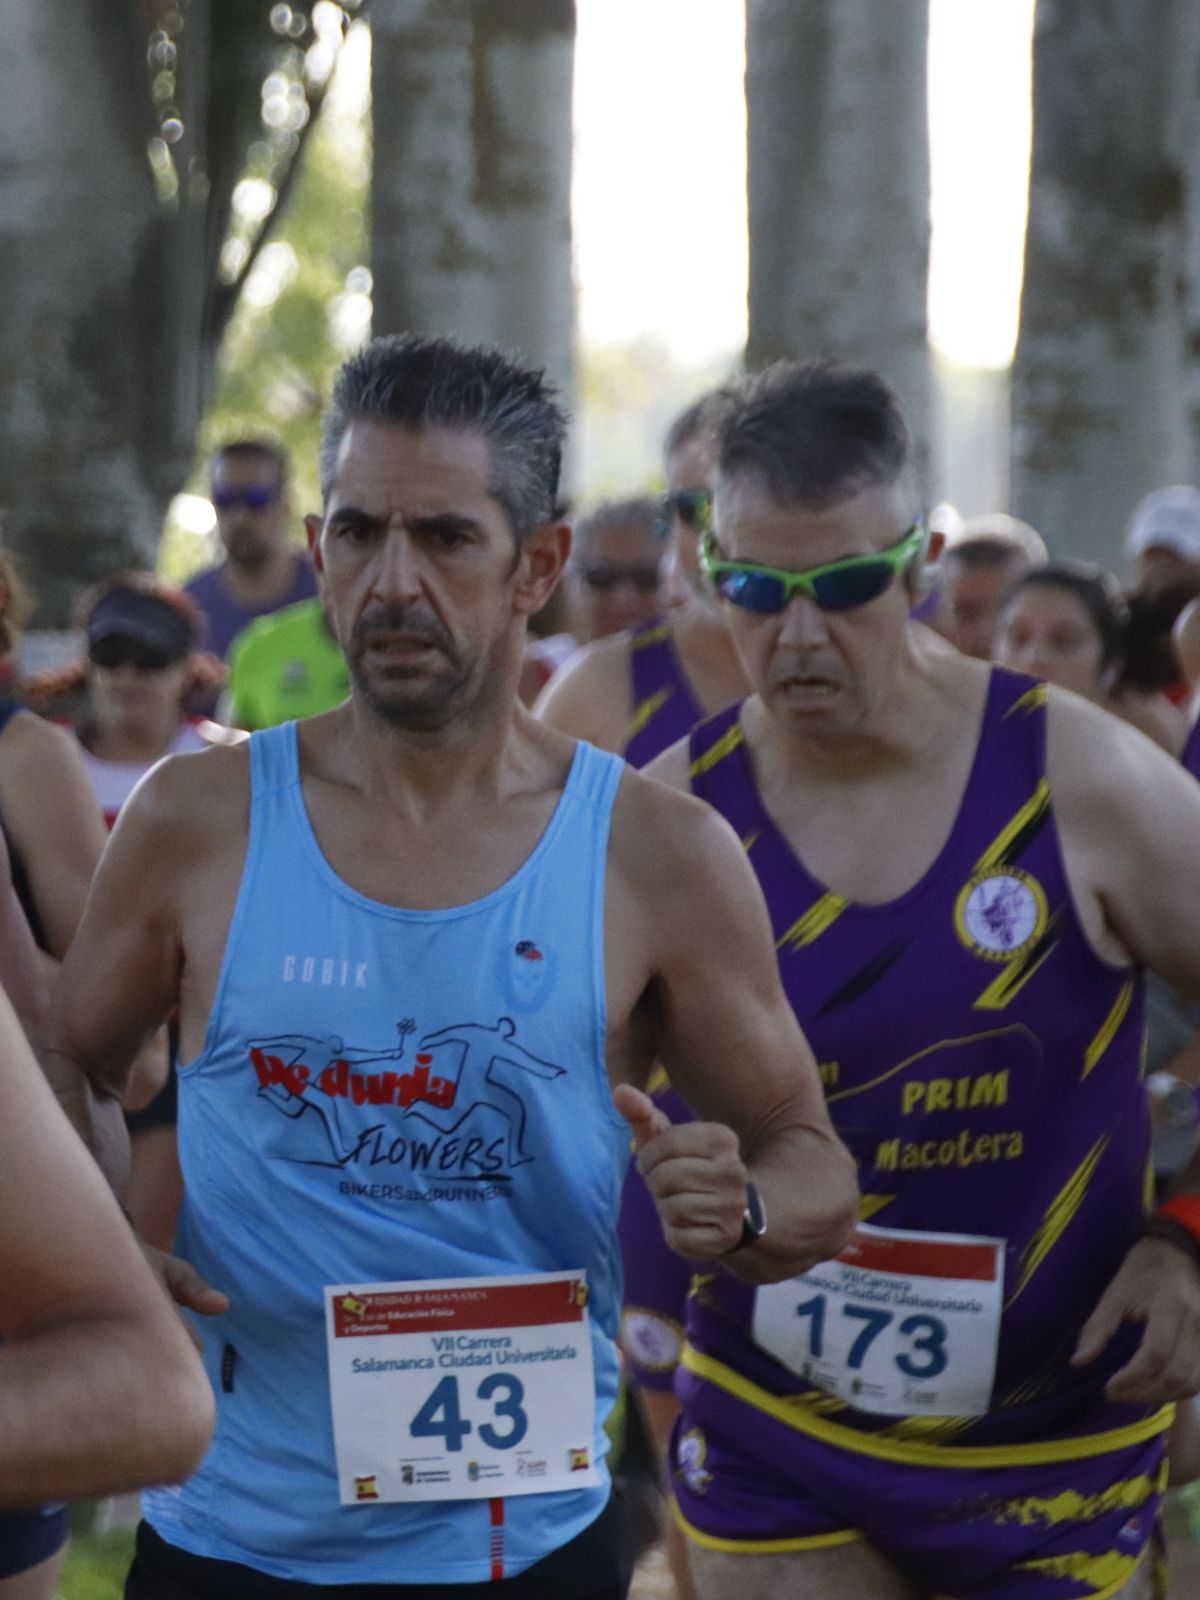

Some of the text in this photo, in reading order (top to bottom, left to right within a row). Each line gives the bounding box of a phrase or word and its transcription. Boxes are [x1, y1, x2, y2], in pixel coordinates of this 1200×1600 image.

[282, 955, 368, 989] GOBIK
[902, 1070, 1010, 1115] PRIM
[349, 1124, 506, 1170] FLOWERS
[875, 1130, 1024, 1172] Macotera
[843, 1282, 891, 1303] Ciudad
[895, 1289, 983, 1314] Universitaria
[860, 1272, 912, 1291] Carrera
[431, 1335, 513, 1352] VII Carrera
[797, 1293, 948, 1379] 173
[352, 1344, 577, 1373] Salamanca Ciudad Universitaria
[409, 1372, 529, 1452] 43
